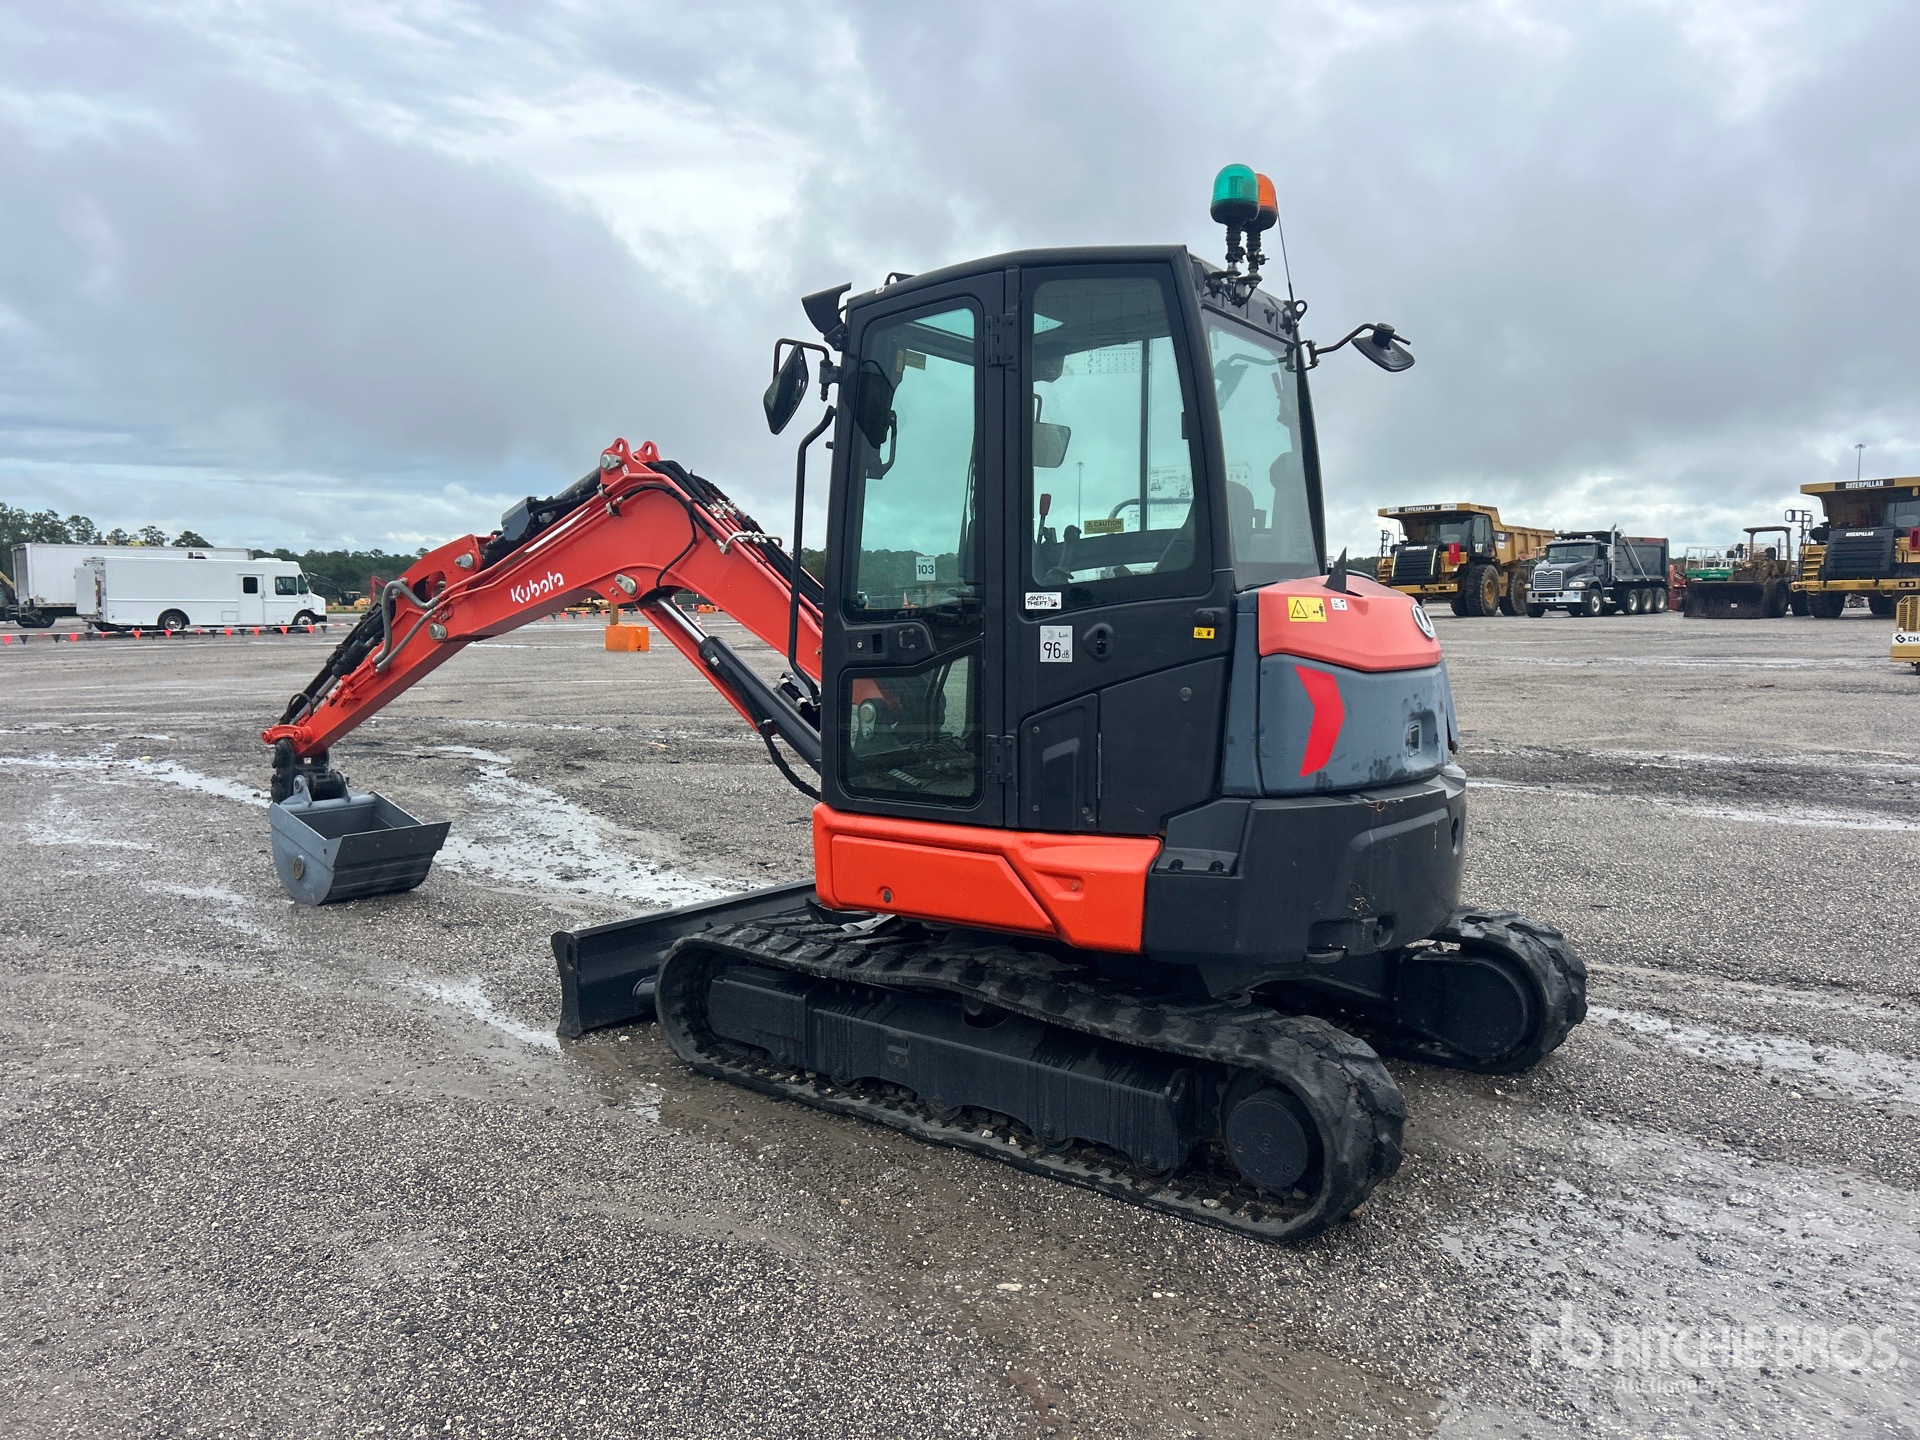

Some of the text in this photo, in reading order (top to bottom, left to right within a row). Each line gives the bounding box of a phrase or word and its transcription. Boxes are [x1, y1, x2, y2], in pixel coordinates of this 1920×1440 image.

[1845, 480, 1884, 489] CATERPILLAR
[1093, 520, 1122, 528] CAUTION
[917, 564, 935, 575] 103
[510, 571, 565, 604] Kubota
[1043, 641, 1070, 659] 96 dB
